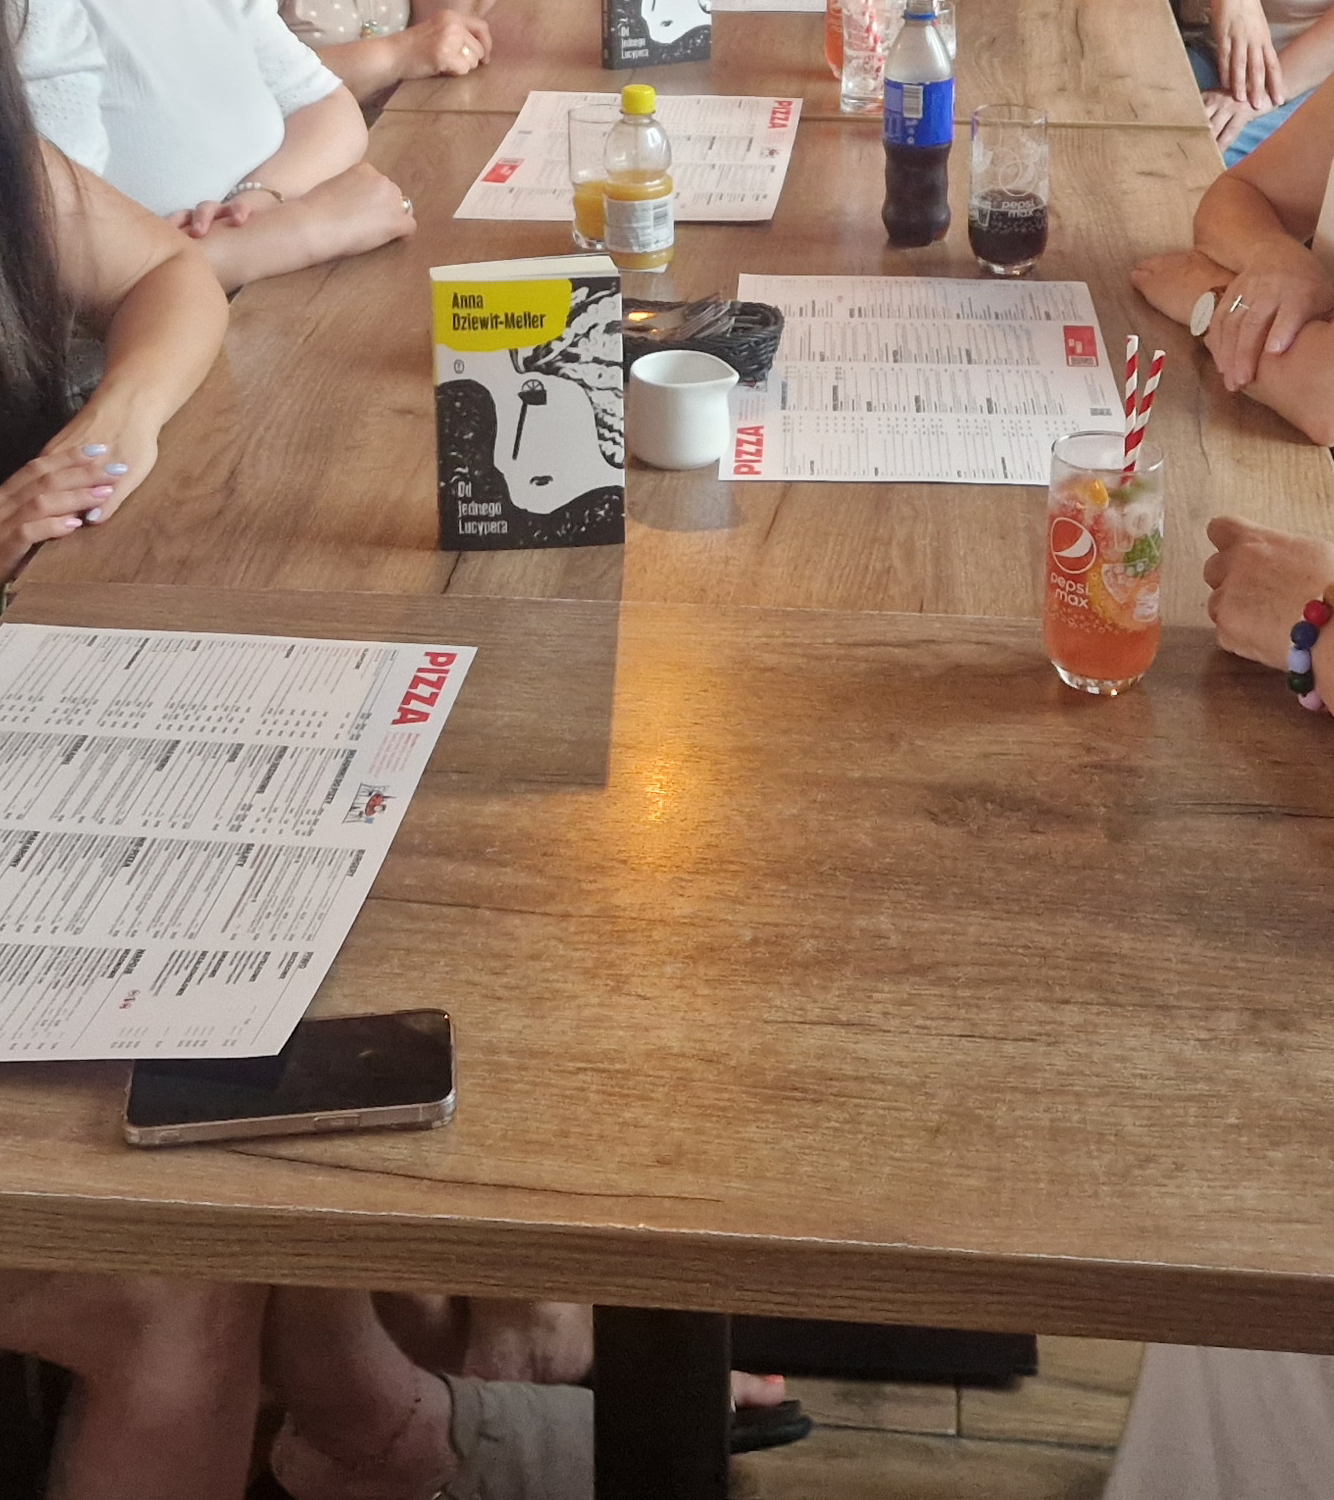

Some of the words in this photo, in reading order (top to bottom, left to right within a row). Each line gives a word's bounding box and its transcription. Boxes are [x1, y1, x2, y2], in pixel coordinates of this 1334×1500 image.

[768, 100, 793, 129] PIZZA
[1002, 198, 1035, 211] pepsi
[452, 292, 483, 309] Anna
[452, 311, 546, 331] Dziewit-Meller
[733, 425, 764, 475] PIZZA
[458, 481, 472, 498] Od
[458, 500, 502, 518] jednego
[458, 519, 508, 536] Lucypera
[1050, 571, 1091, 596] pepsi
[1056, 588, 1089, 609] max
[391, 651, 458, 726] PIZZA
